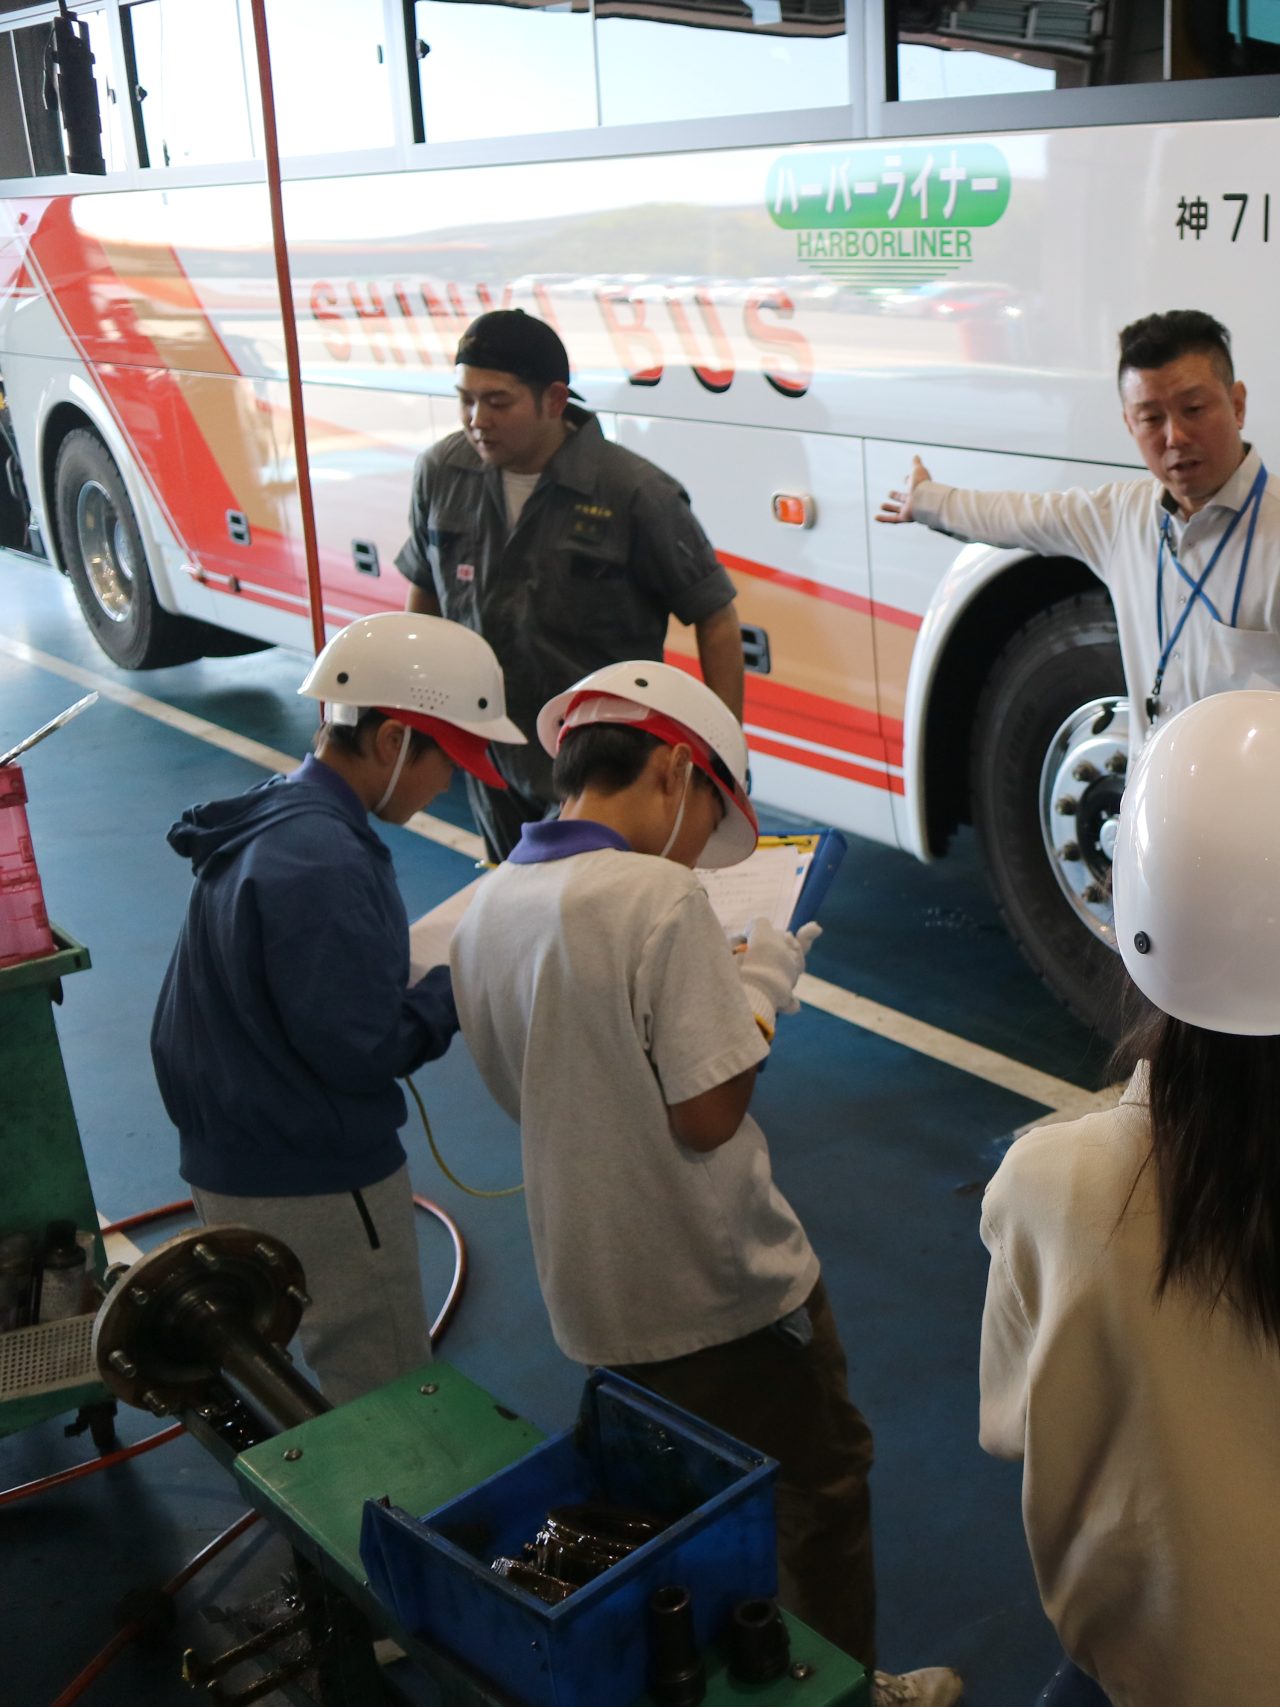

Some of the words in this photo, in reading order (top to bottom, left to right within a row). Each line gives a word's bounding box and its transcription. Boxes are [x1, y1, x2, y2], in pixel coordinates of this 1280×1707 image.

[773, 149, 998, 221] ハーバーライナー
[797, 229, 973, 257] HARBORLINER
[594, 286, 815, 399] BUS
